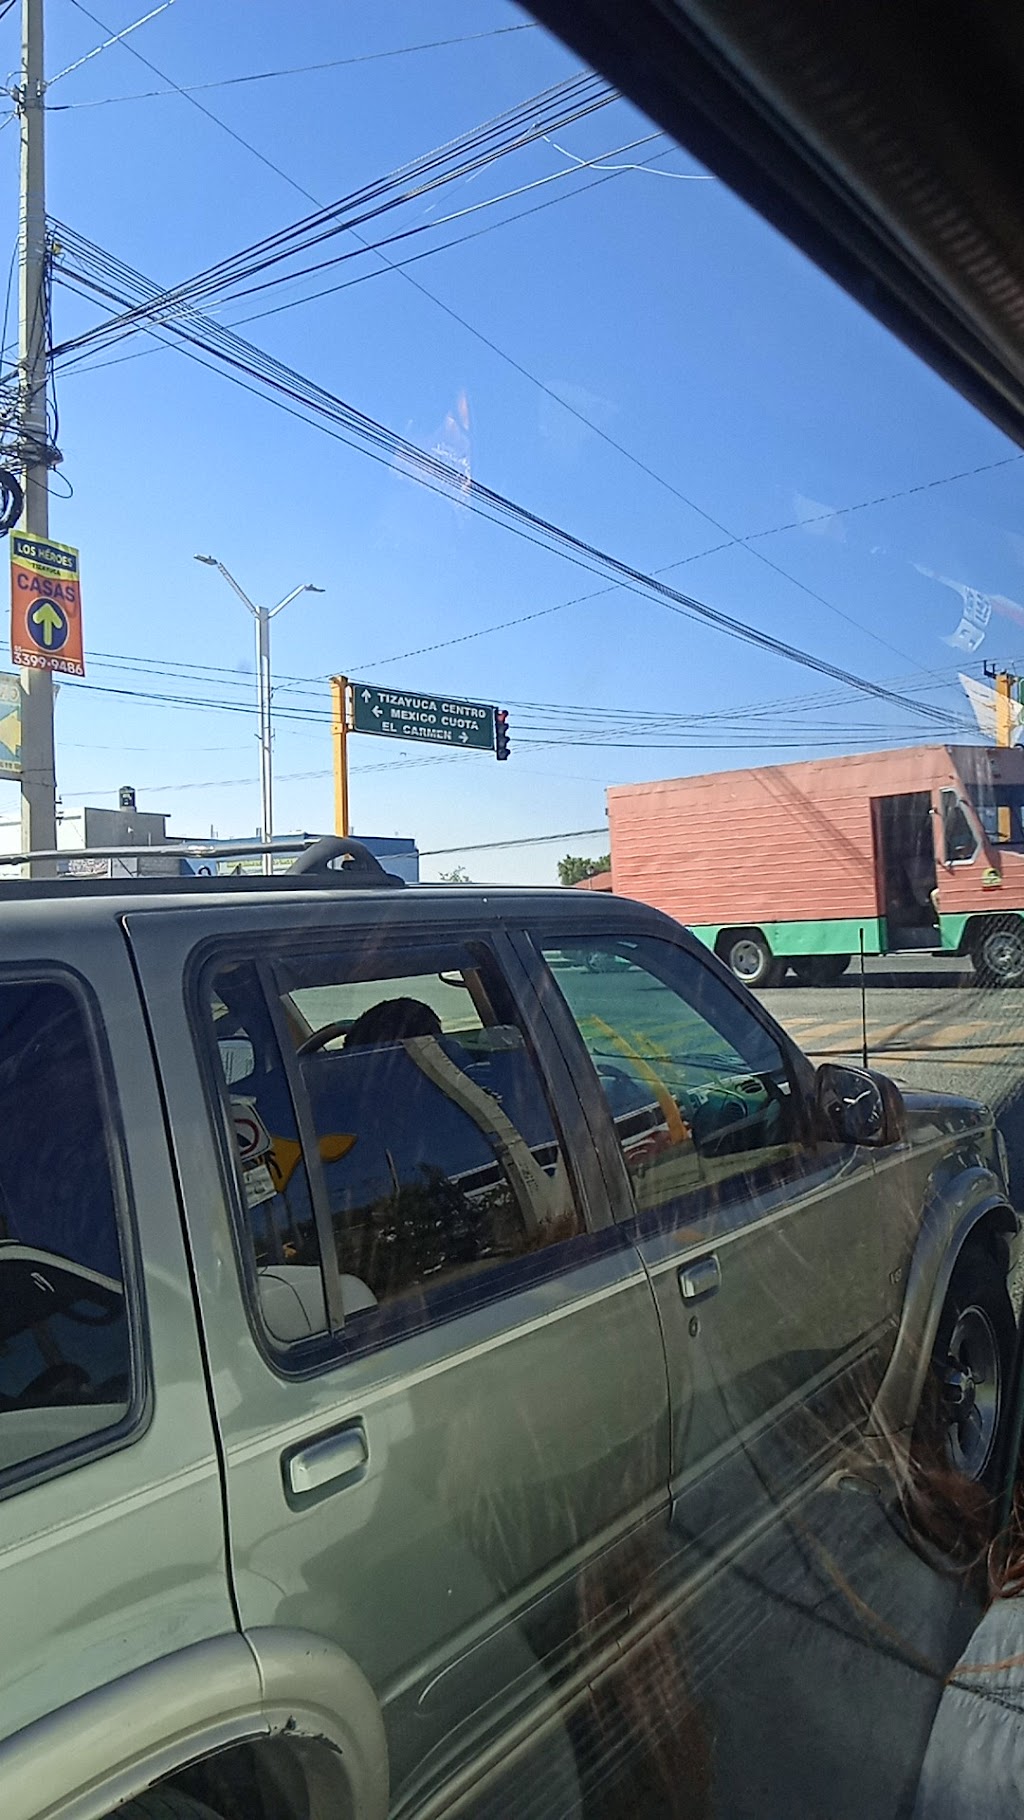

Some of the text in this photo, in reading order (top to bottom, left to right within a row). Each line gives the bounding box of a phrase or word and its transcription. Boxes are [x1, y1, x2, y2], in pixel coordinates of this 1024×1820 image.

[17, 543, 73, 567] LOS HÉROES
[17, 573, 75, 602] CASAS
[377, 693, 486, 718] TIZAYUCA CENTRO
[382, 721, 452, 741] EL CARMEN
[390, 708, 479, 730] MEXICO CUOTA
